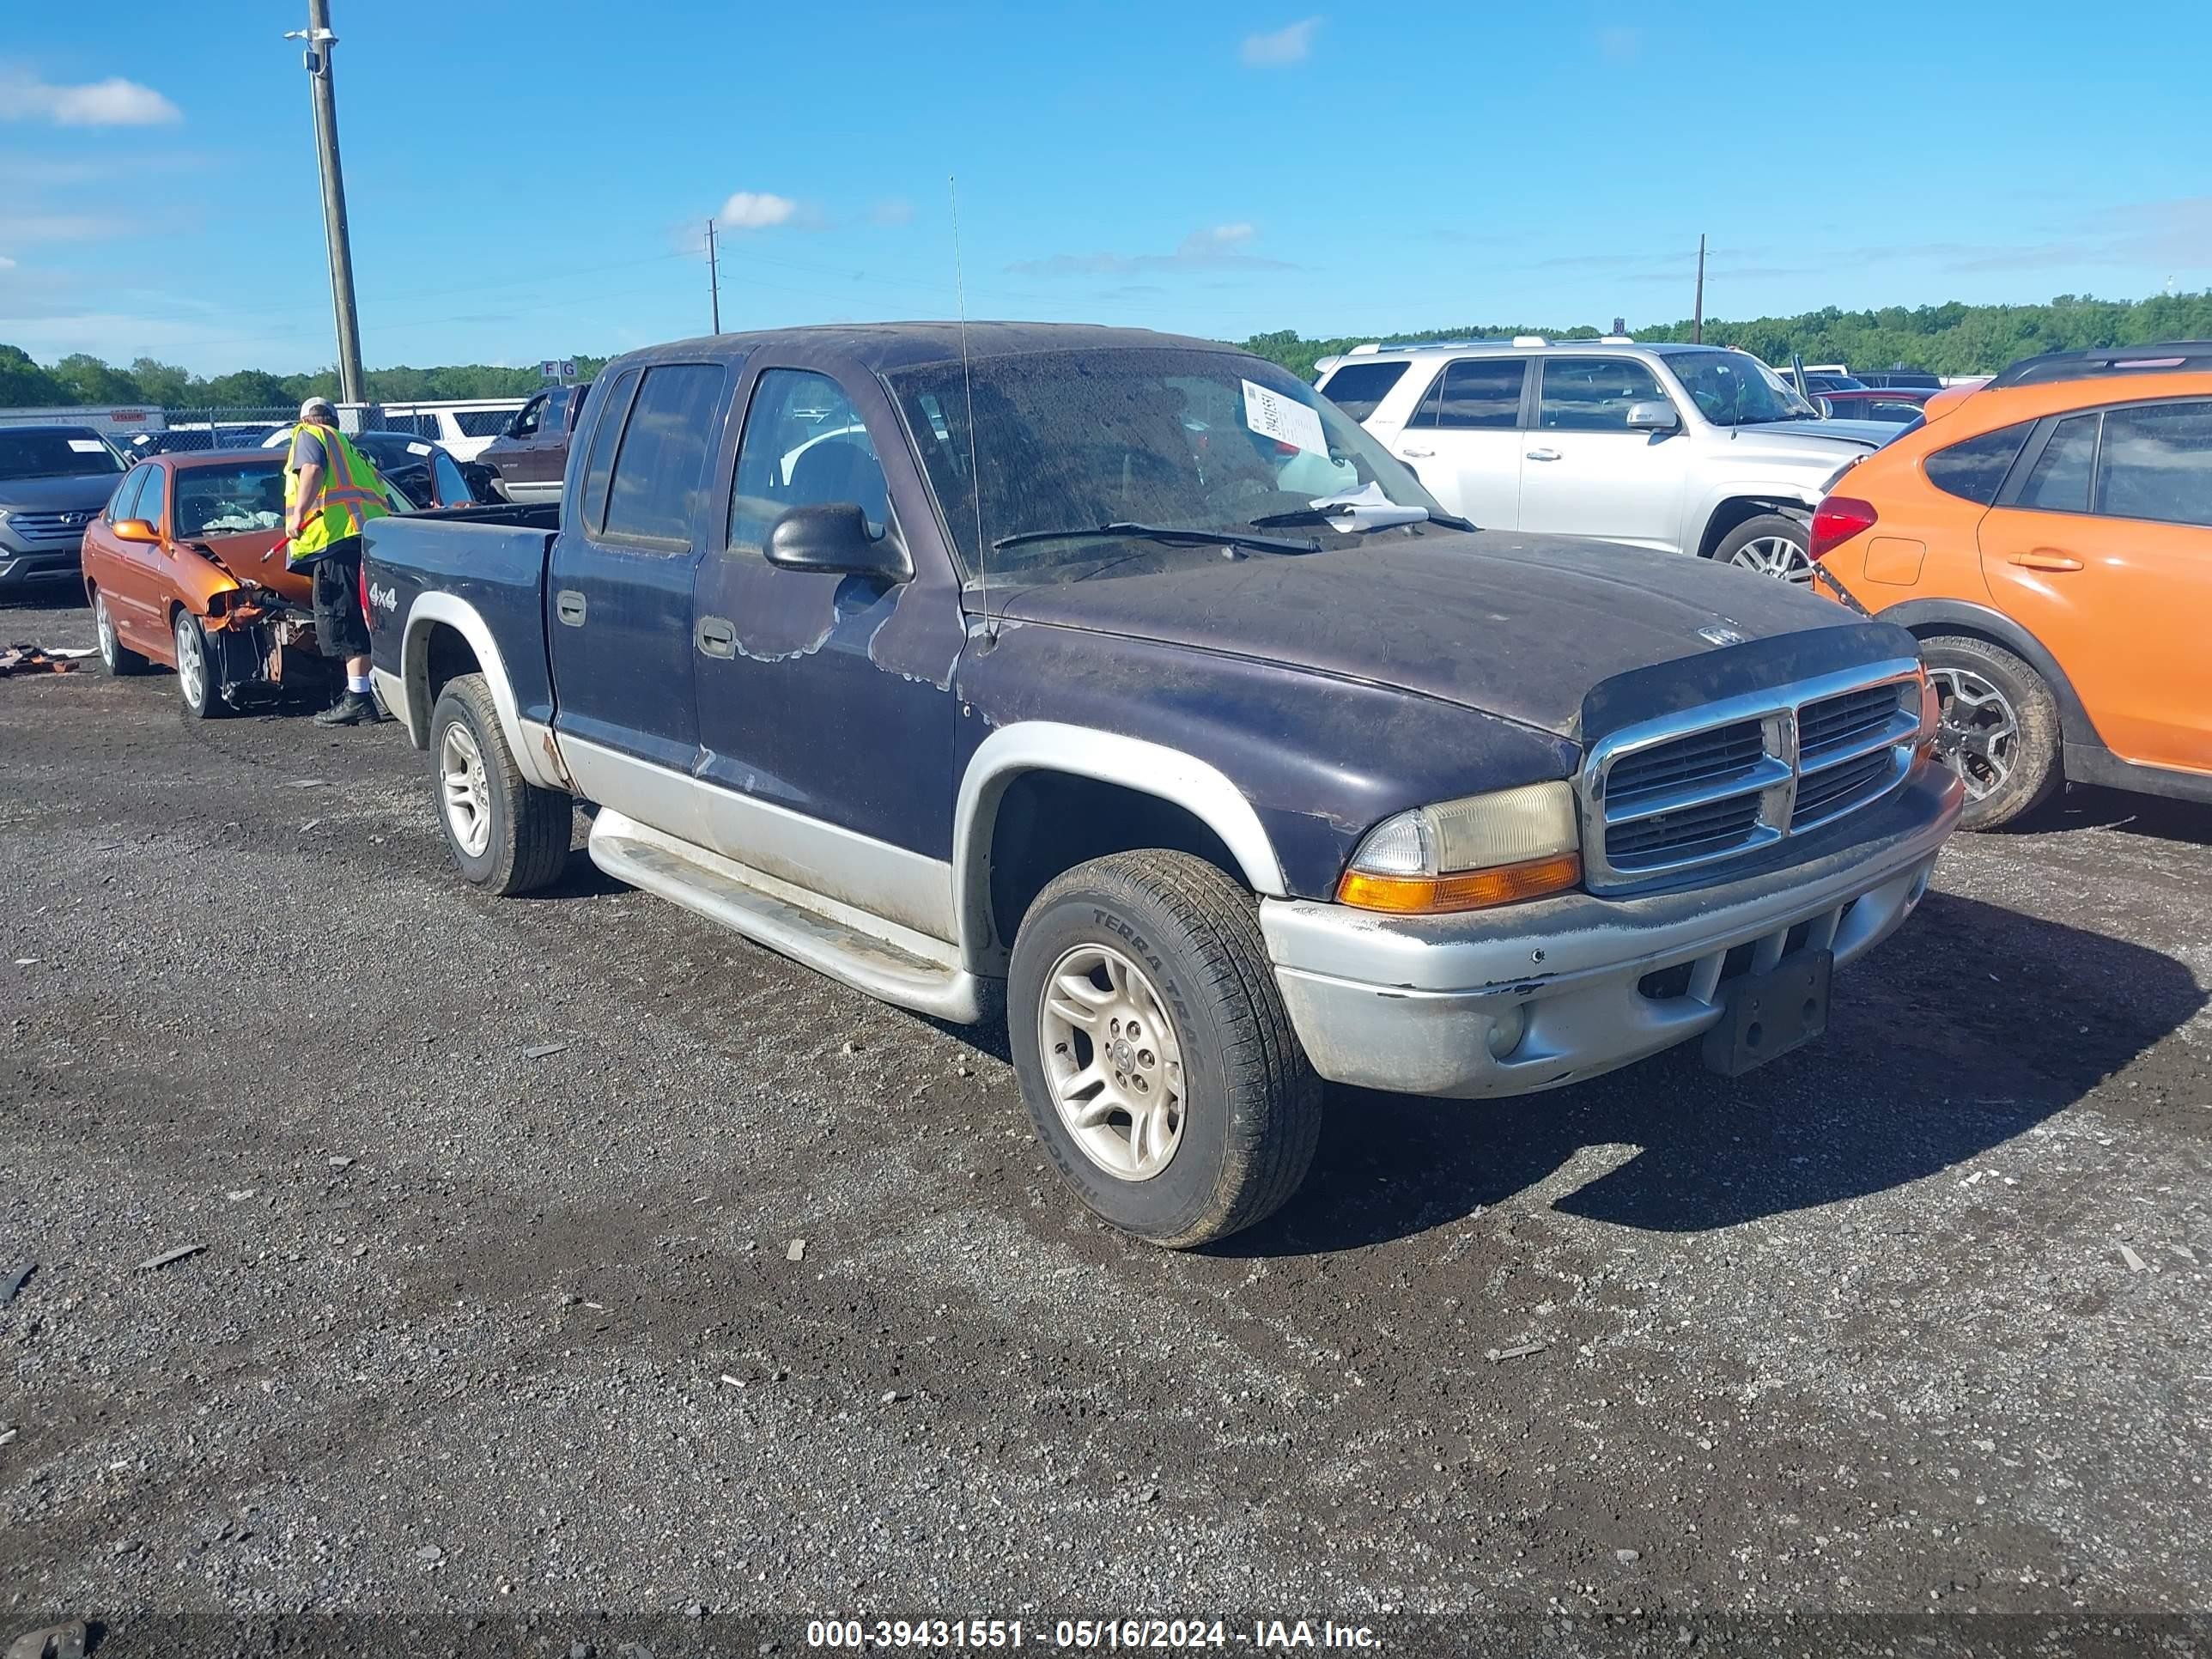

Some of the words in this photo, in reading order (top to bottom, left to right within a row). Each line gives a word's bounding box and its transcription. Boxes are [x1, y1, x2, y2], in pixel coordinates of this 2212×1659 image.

[1614, 322, 1625, 334] 30
[545, 363, 553, 375] F
[563, 363, 574, 375] G
[369, 582, 398, 612] 4x4
[1092, 908, 1164, 973] TERRA
[1164, 979, 1204, 1072] TRAC
